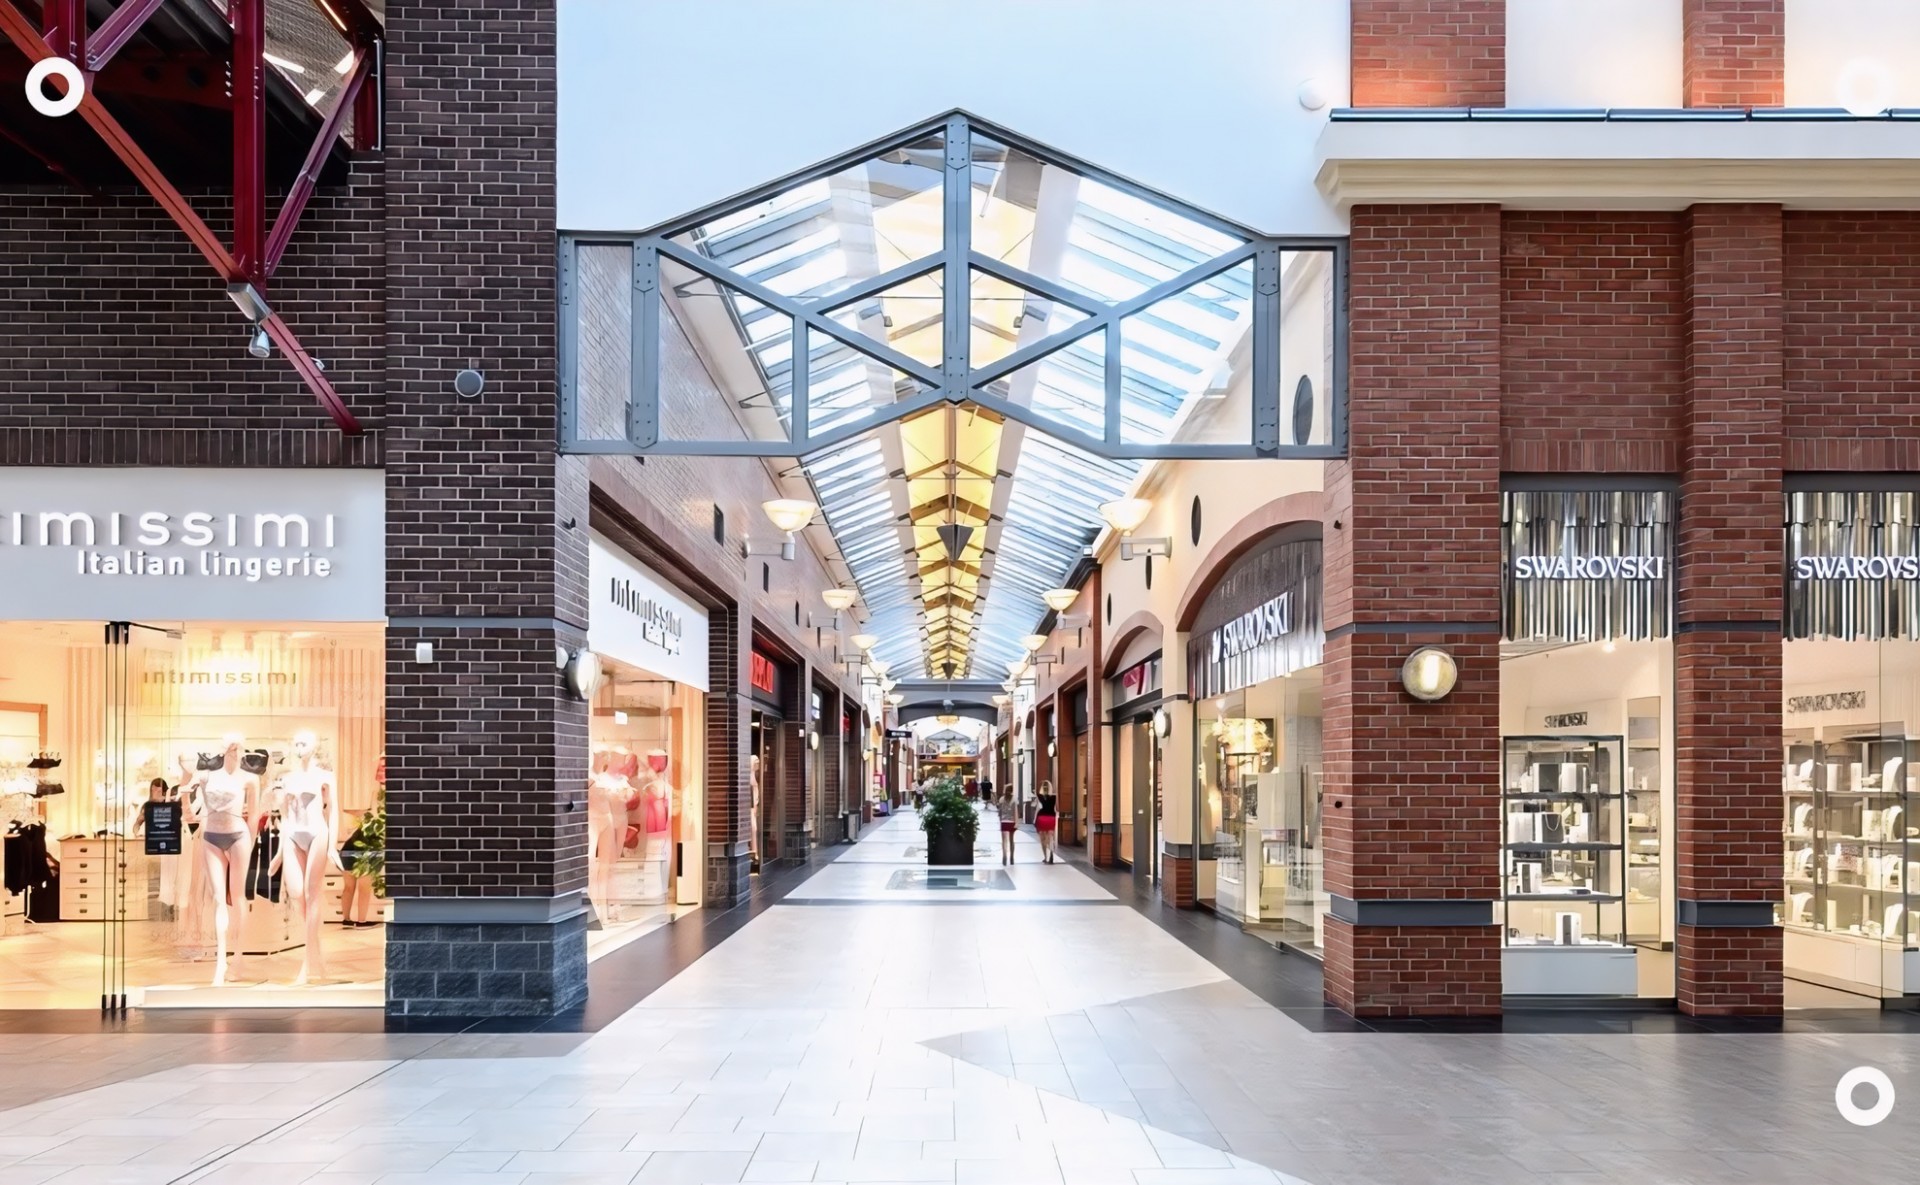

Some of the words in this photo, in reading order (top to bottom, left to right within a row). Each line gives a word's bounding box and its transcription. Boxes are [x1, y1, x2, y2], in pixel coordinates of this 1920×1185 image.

[77, 549, 185, 575] Italian
[200, 549, 331, 582] lingerie
[1515, 555, 1664, 579] SWAROVSKI
[1223, 591, 1289, 659] SWAROVSKI
[144, 669, 296, 685] intimissimi
[1787, 690, 1866, 713] SWAROVSKI
